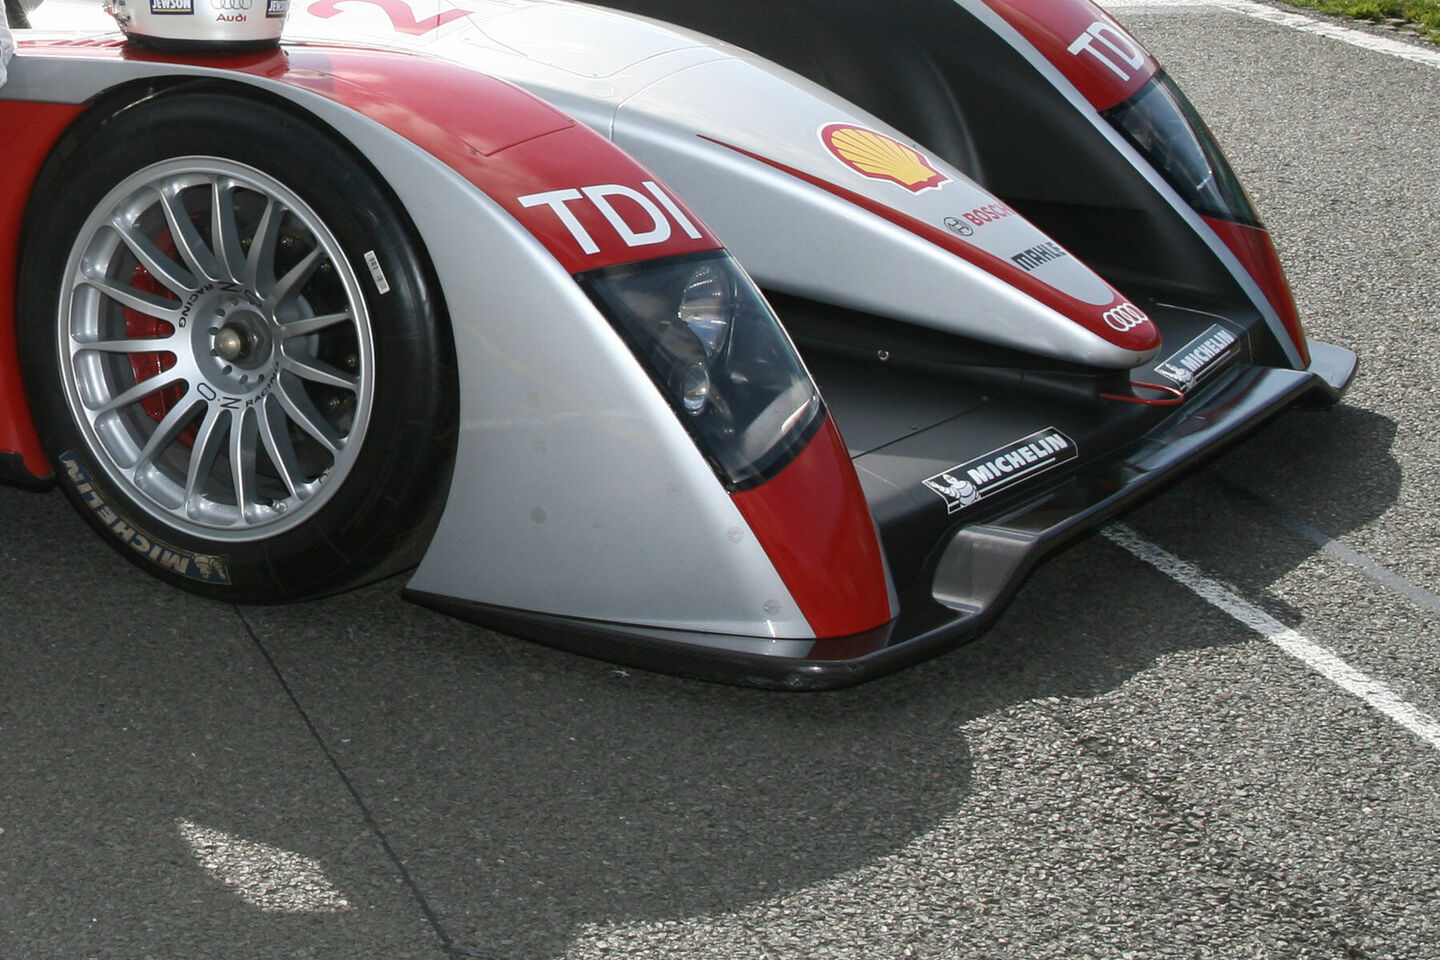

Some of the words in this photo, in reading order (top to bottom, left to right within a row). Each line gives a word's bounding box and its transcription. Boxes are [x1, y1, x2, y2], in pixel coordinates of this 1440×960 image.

[216, 13, 247, 23] Audi
[517, 180, 702, 255] TDI
[962, 201, 1018, 227] BOSCH
[1010, 240, 1068, 271] MAHLE
[1179, 328, 1236, 371] MICHELIN
[966, 433, 1068, 485] MICHELIN
[62, 459, 190, 575] MICHELIN
